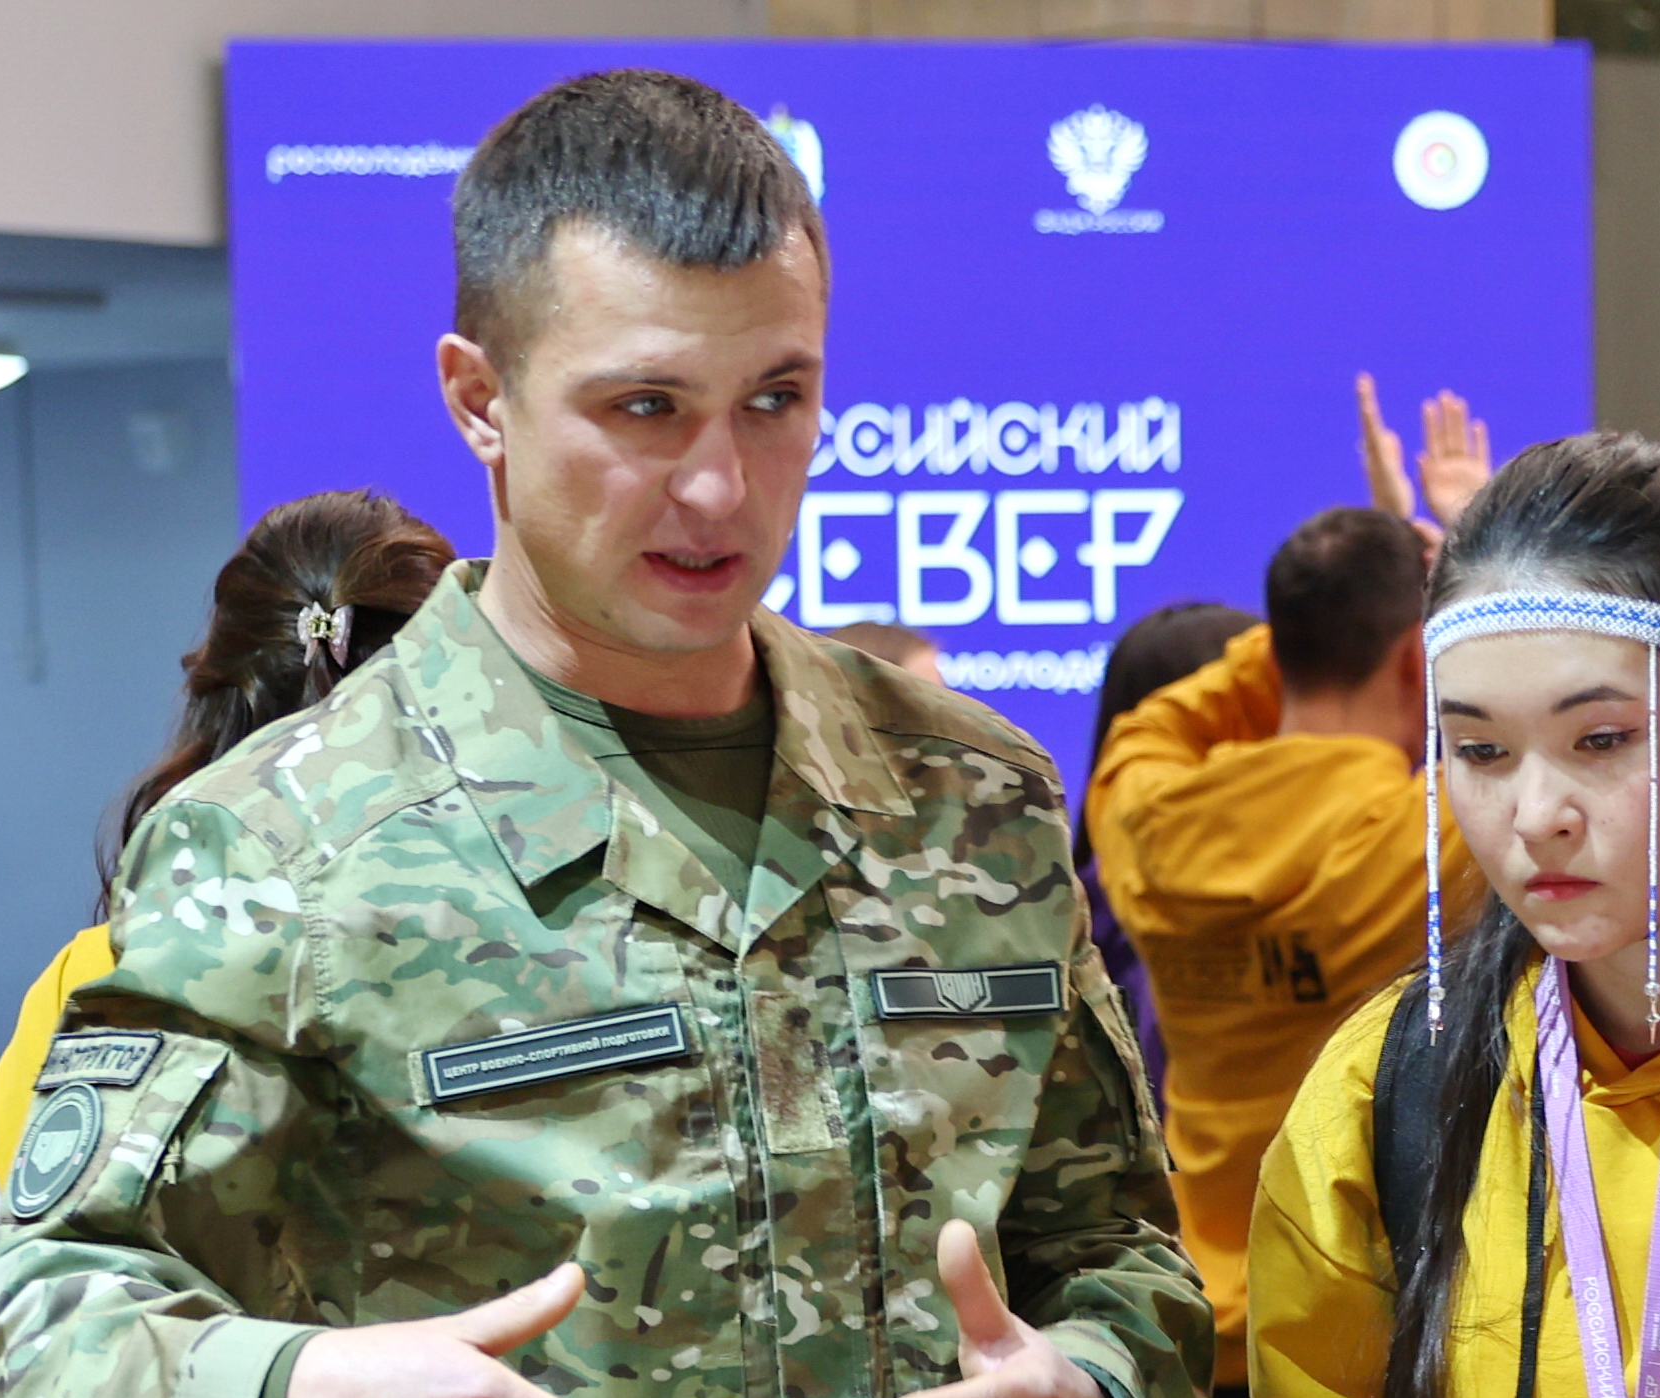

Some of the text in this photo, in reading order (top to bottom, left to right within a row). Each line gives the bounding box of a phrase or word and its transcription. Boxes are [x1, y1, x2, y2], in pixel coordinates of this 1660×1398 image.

[760, 488, 1184, 628] ЕВЕР
[443, 1025, 671, 1080] ЦЕНТР ВОЕННО-СПОРТИВНОЙ ПОДГОТОВКИ
